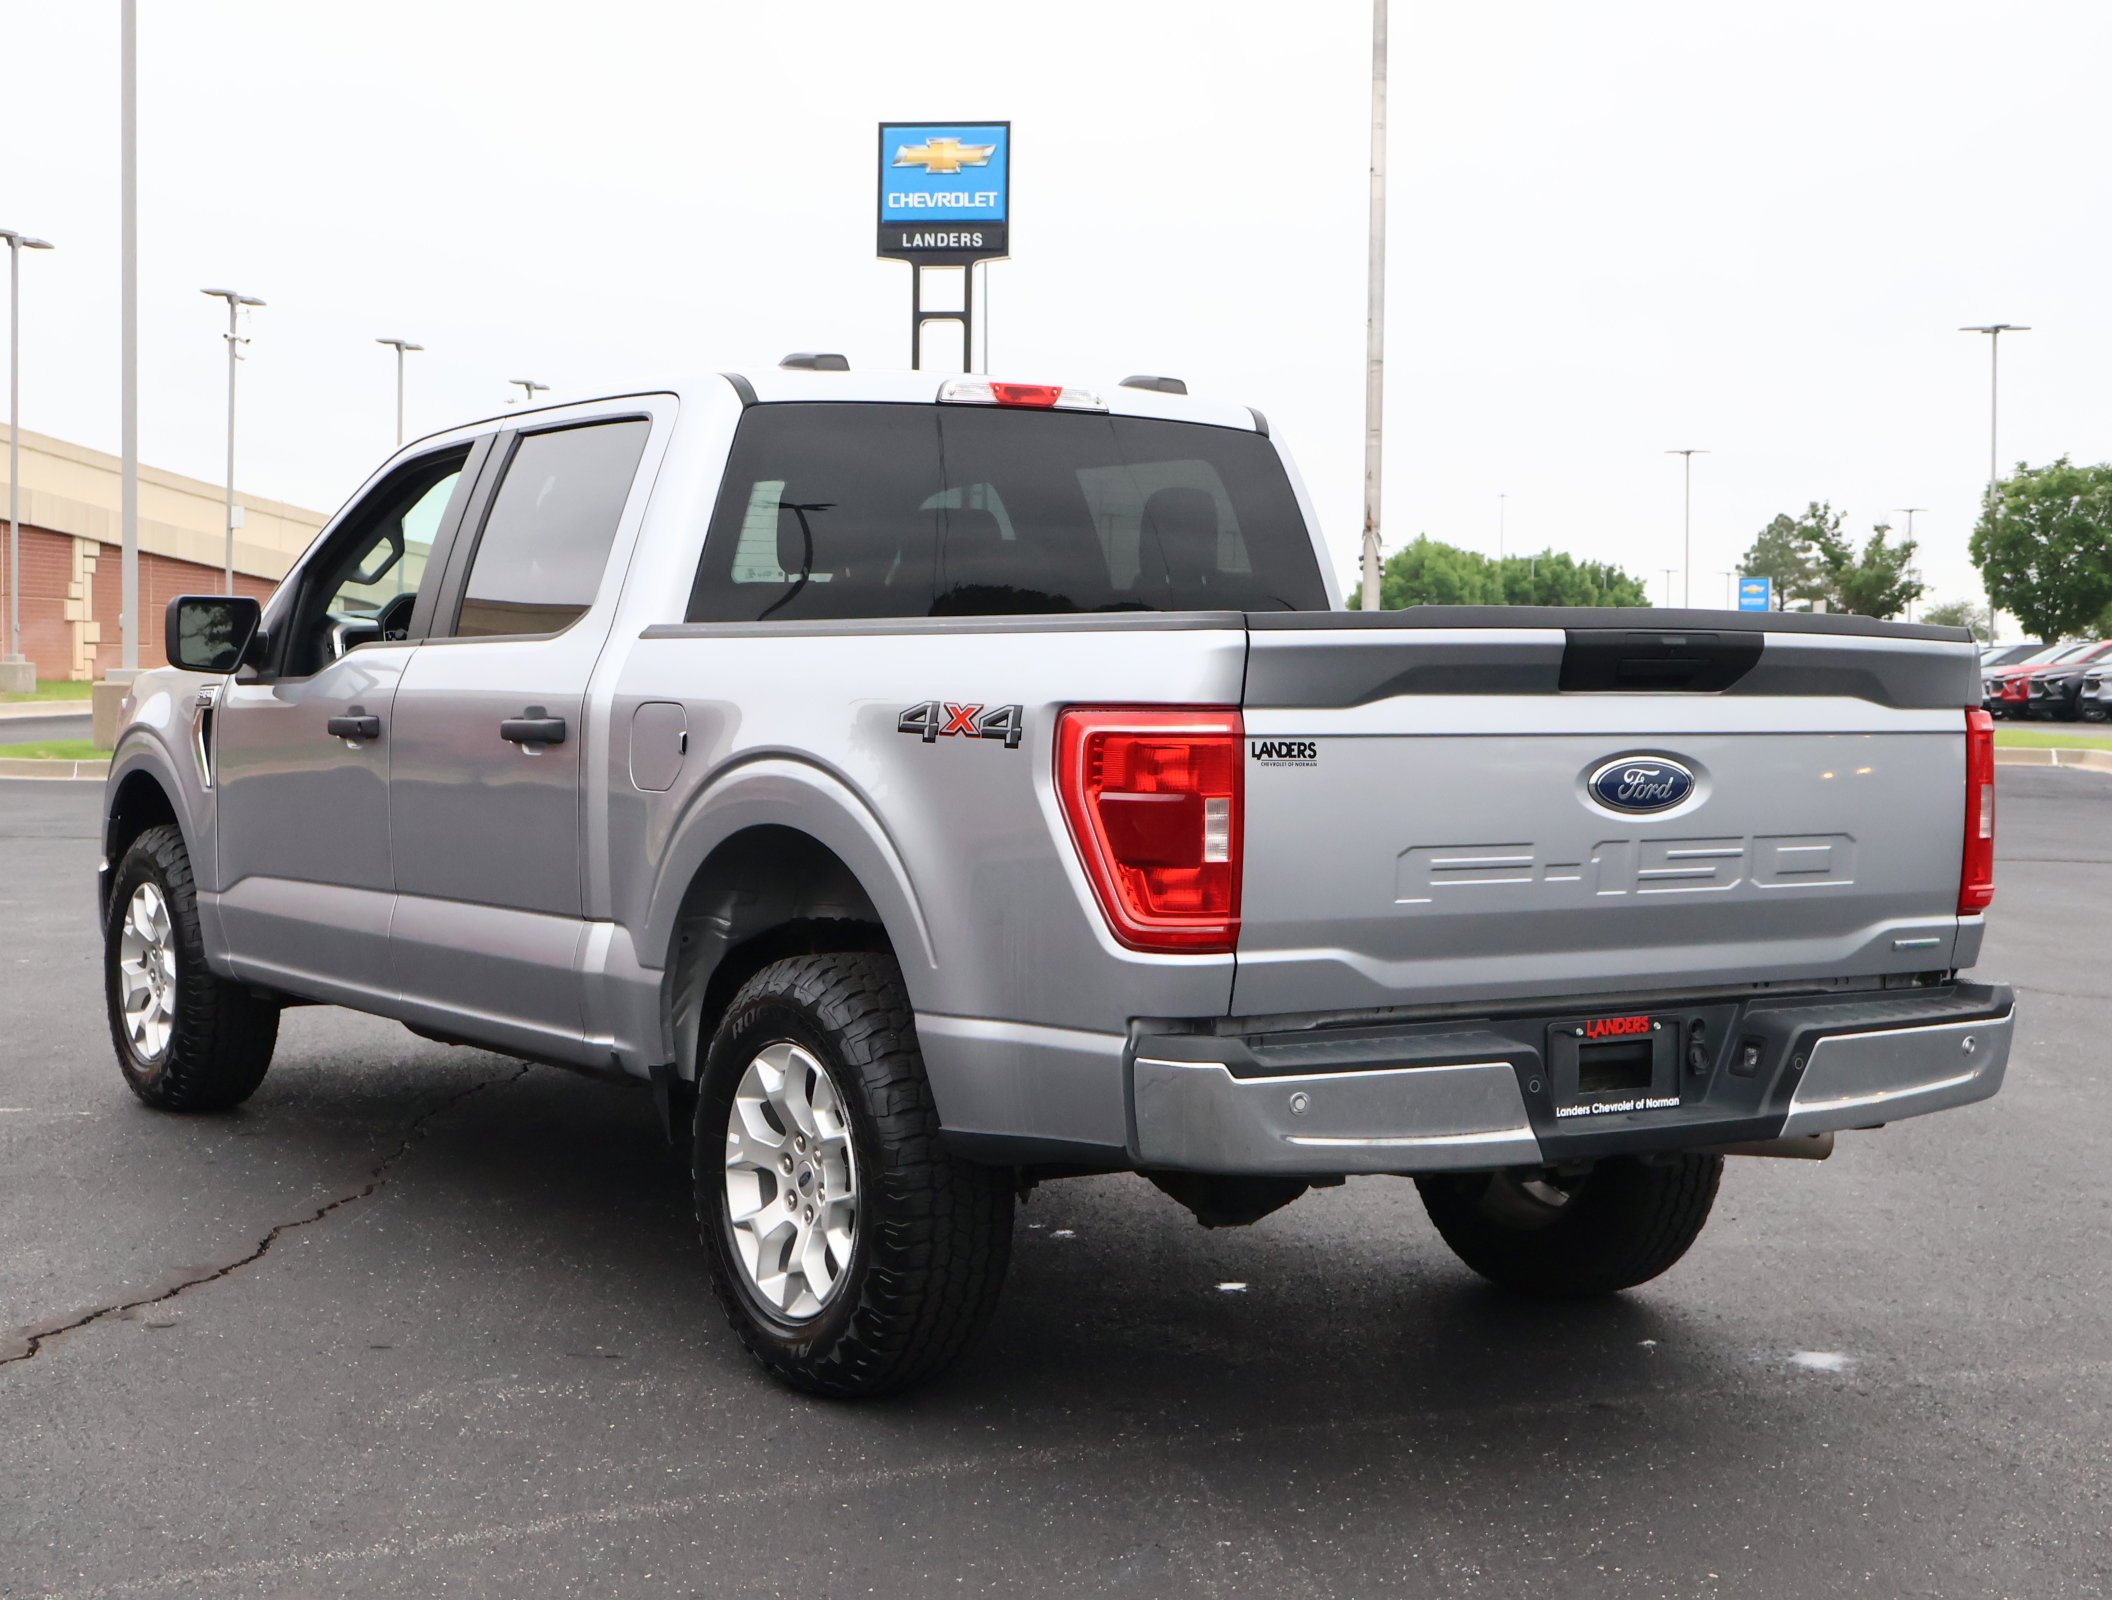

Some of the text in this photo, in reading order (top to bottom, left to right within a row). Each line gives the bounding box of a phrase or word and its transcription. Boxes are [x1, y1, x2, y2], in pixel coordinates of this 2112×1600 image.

[888, 192, 998, 208] CHEVROLET
[902, 232, 983, 247] LANDERS
[1251, 741, 1317, 760] LANDERS
[1617, 768, 1674, 800] Ford
[1395, 832, 1857, 904] F-150
[1586, 1016, 1649, 1038] LANDERS
[1556, 1097, 1680, 1118] Landers Chevrolet of Norman
